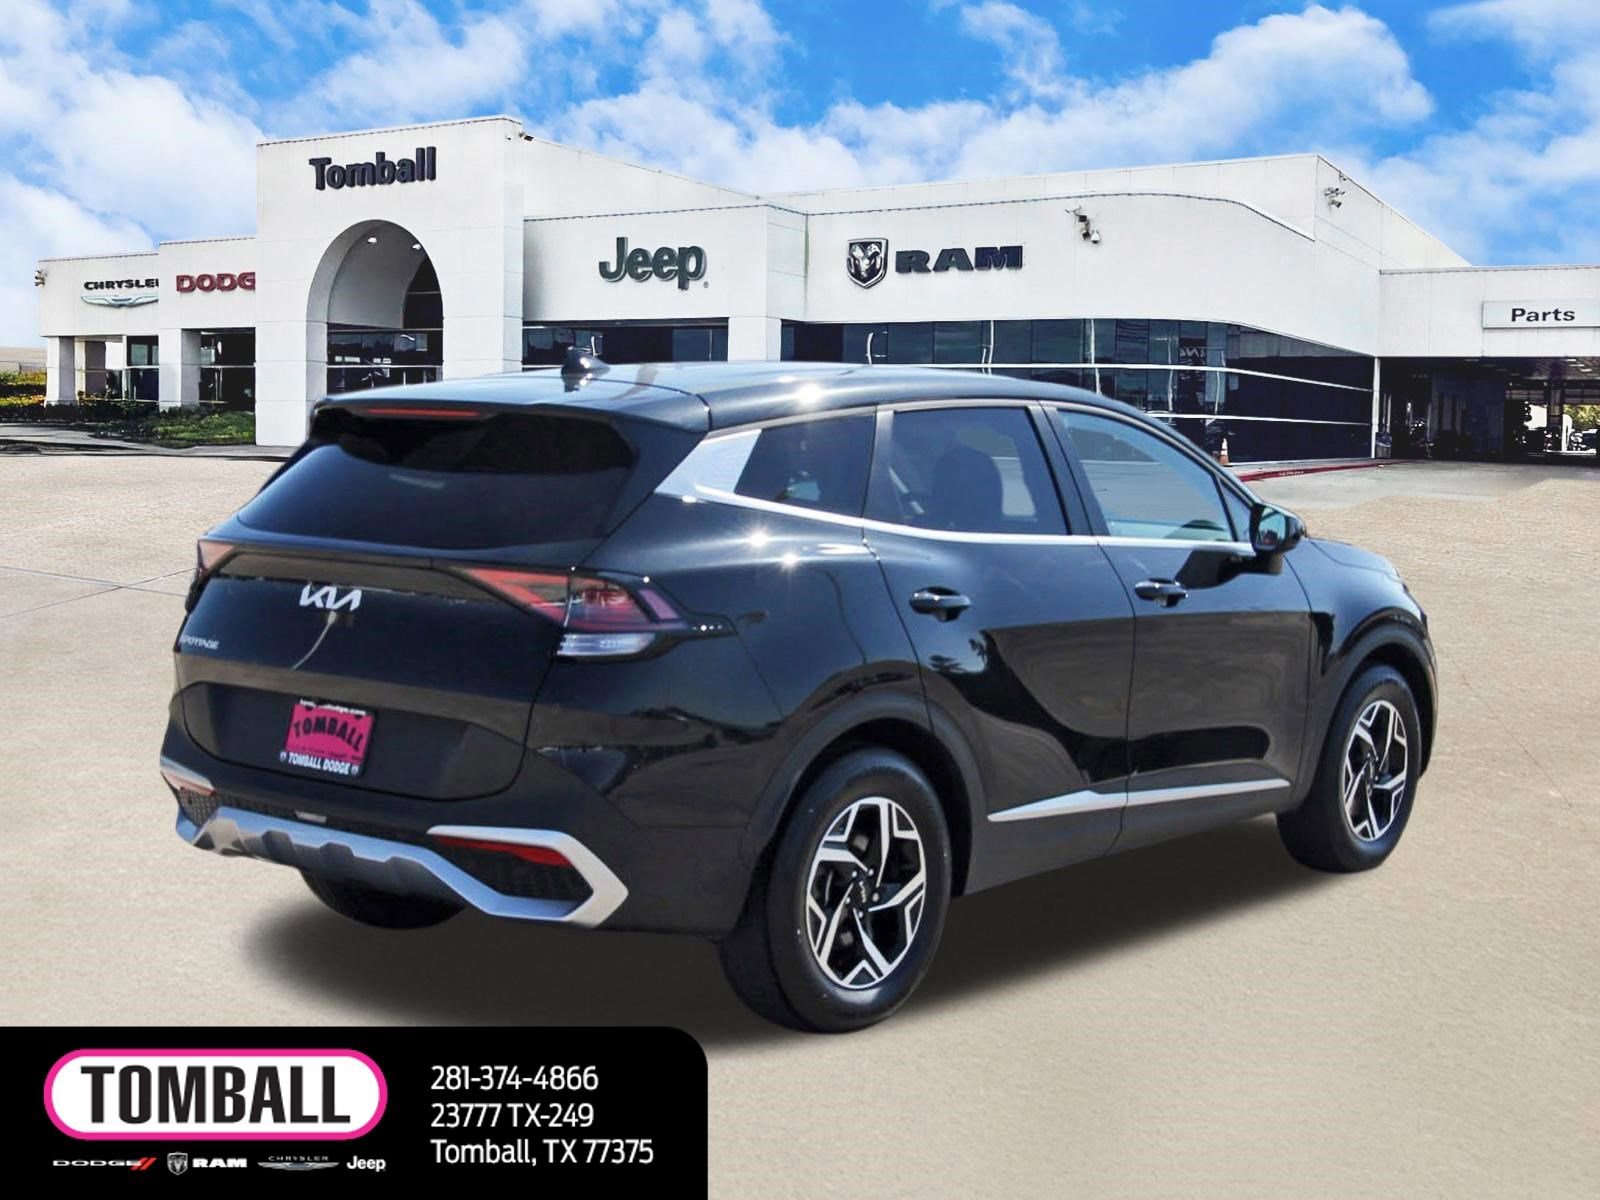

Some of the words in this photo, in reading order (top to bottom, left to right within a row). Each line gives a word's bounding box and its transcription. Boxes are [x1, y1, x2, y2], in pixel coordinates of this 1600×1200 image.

[309, 146, 437, 190] Tomball
[598, 236, 707, 291] Jeep
[895, 245, 1023, 275] RAM
[1511, 306, 1576, 322] Parts
[299, 585, 362, 611] KIA
[293, 716, 363, 752] TOMBALL
[322, 759, 351, 775] DODGE
